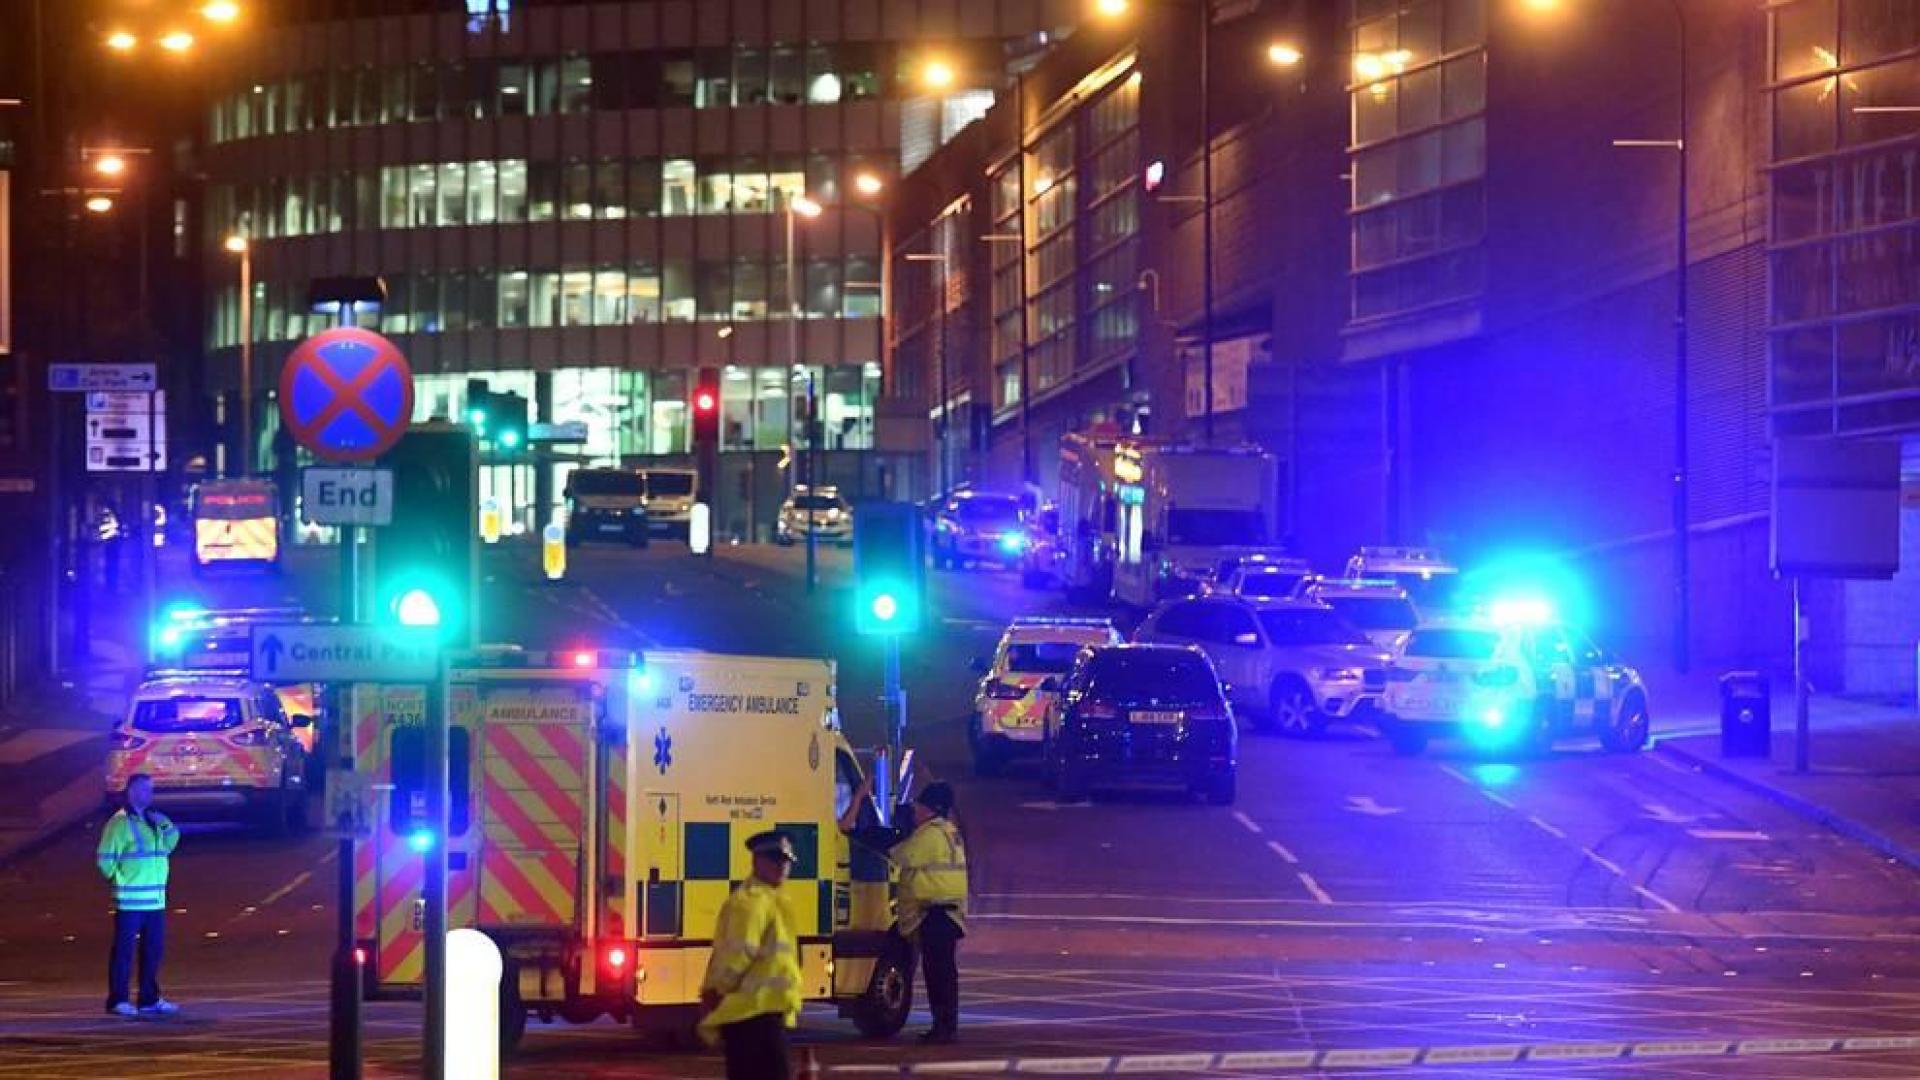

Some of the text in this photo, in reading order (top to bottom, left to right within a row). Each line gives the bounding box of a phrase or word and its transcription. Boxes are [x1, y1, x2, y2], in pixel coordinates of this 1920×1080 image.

[319, 480, 377, 507] End
[291, 639, 373, 661] Central
[491, 706, 577, 721] AMBULANCE
[688, 693, 743, 713] EMERGENCY
[746, 696, 800, 714] AMBULANCE
